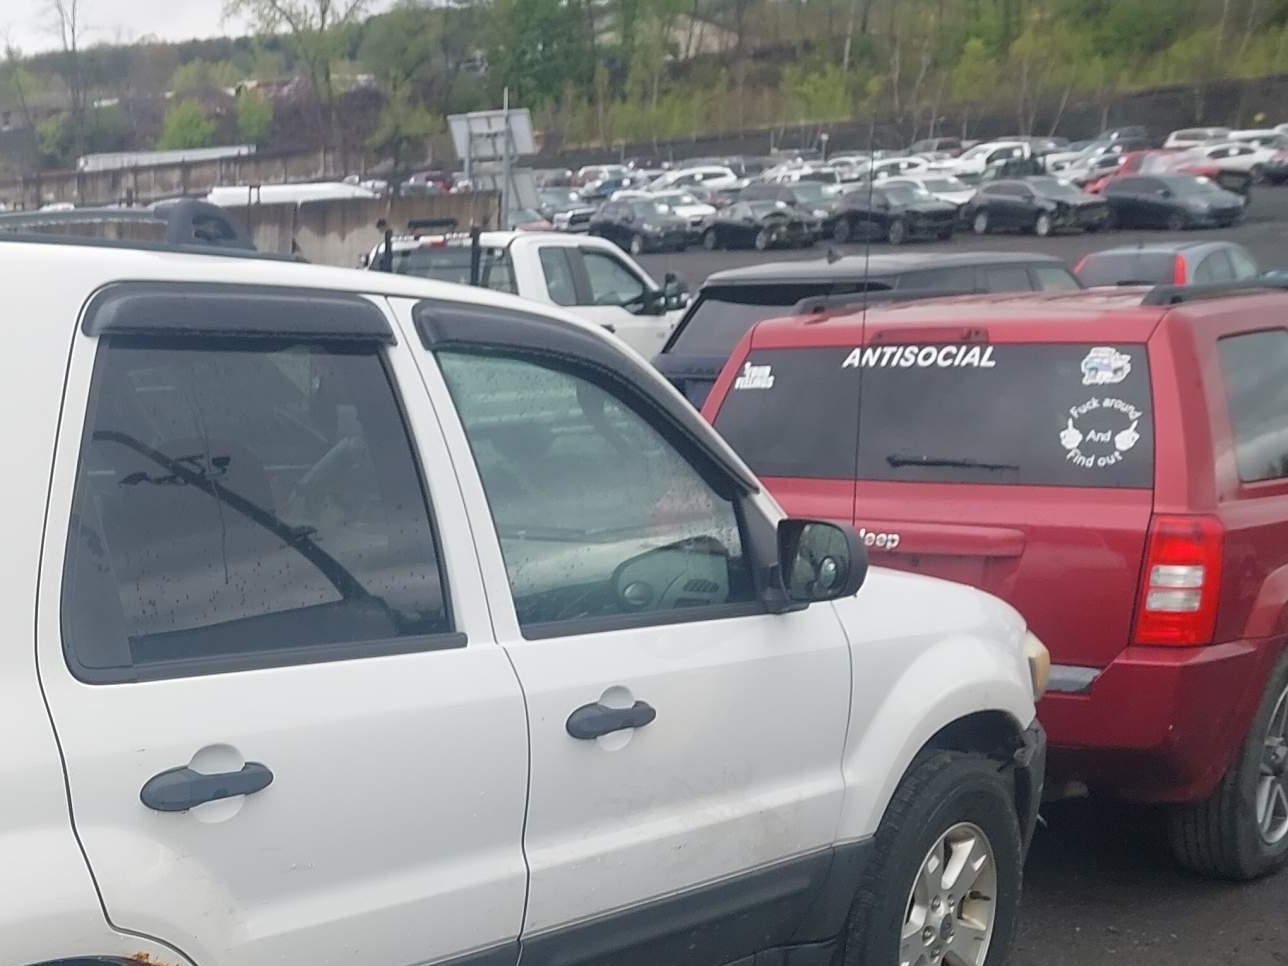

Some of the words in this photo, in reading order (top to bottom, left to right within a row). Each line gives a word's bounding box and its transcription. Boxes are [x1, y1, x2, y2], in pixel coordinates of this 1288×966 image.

[841, 345, 997, 368] ANTISOCIAL
[1069, 397, 1100, 419] Fuck
[1102, 398, 1143, 421] around
[1085, 429, 1112, 442] And
[1097, 451, 1123, 468] out
